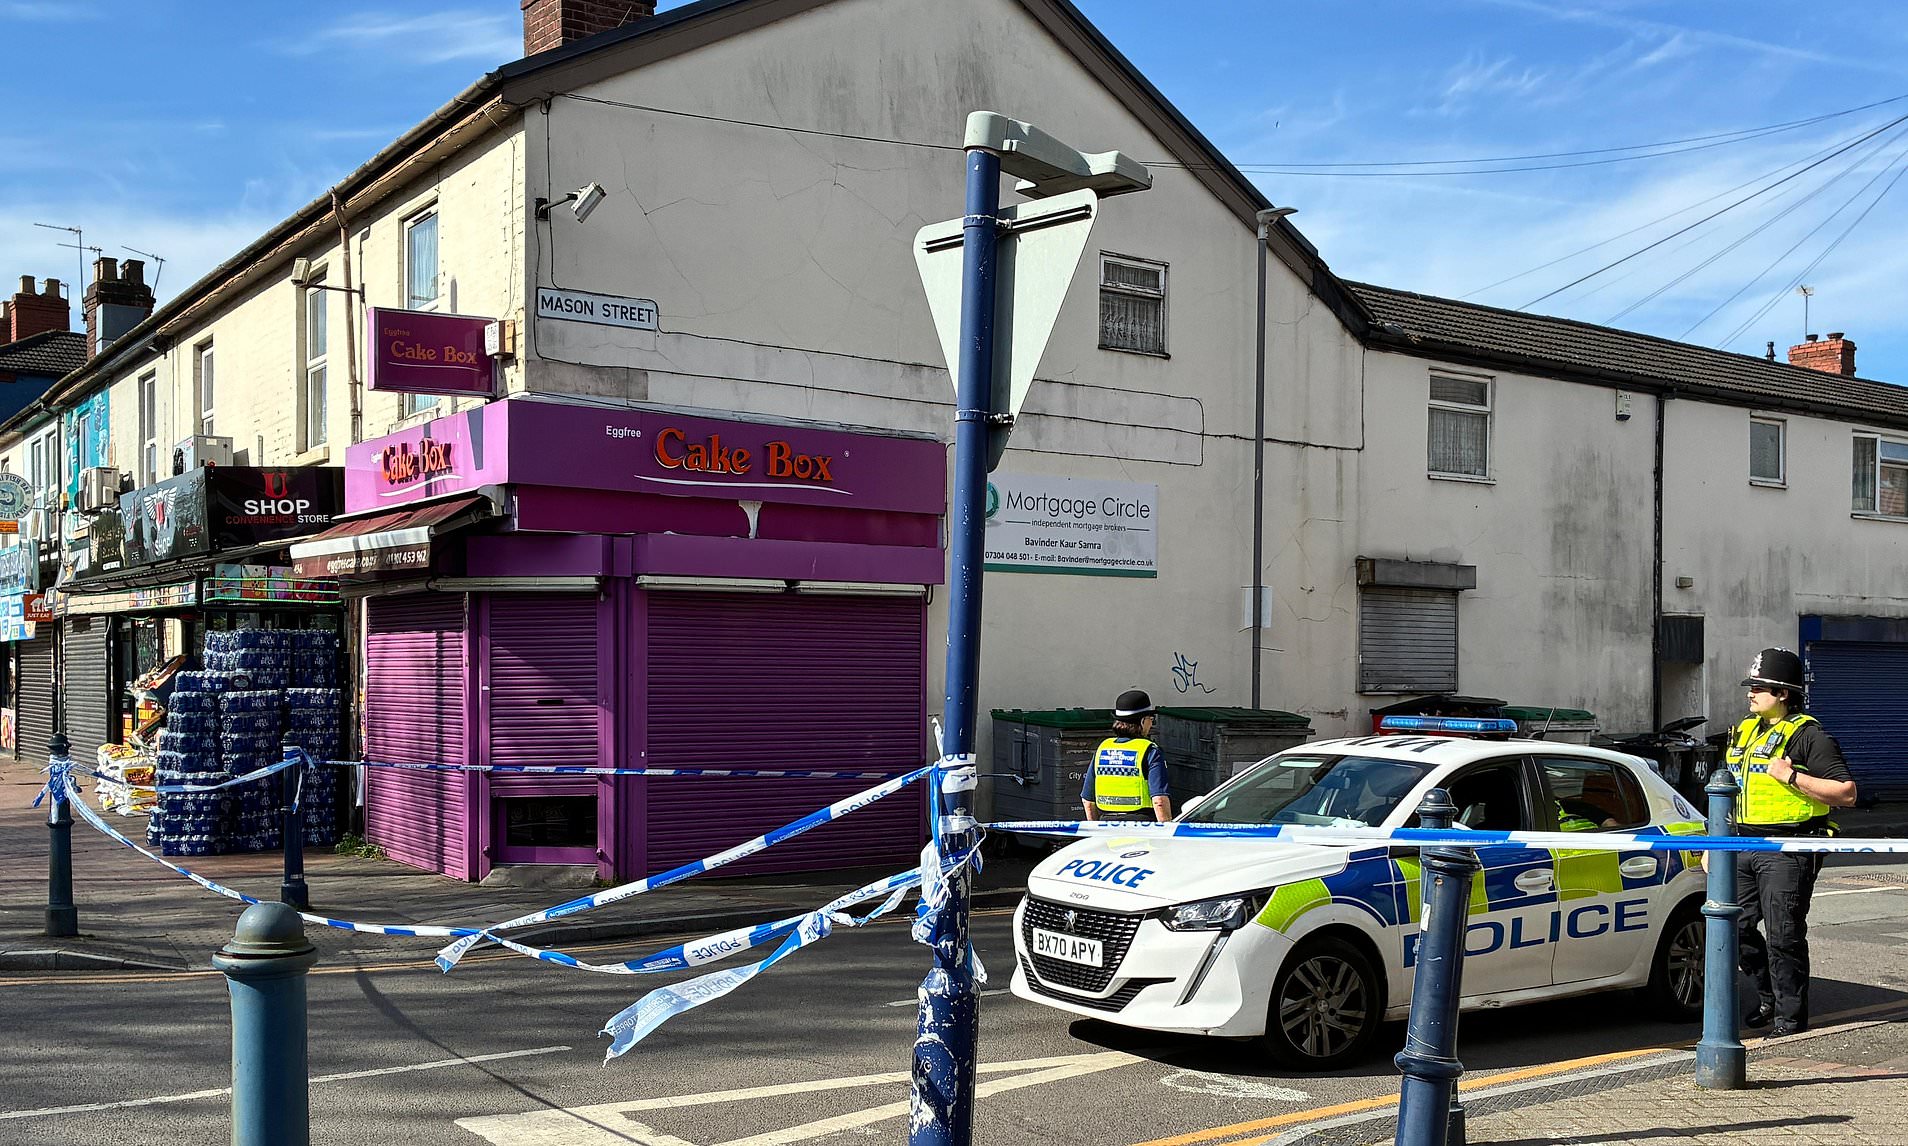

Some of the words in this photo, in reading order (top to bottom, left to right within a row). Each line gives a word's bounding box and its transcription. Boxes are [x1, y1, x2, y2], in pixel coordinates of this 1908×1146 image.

[541, 295, 594, 316] MASON
[602, 303, 654, 323] STREET
[384, 327, 411, 337] Eggfree
[390, 340, 437, 361] Cake
[443, 346, 478, 364] Box
[606, 425, 641, 439] Eggfree
[381, 443, 415, 485] Cake
[419, 437, 450, 473] Box
[654, 427, 752, 475] Cake
[765, 441, 833, 481] Box
[262, 473, 288, 499] U
[244, 499, 310, 516] SHOP
[1006, 490, 1097, 518] Mortgage
[1102, 497, 1151, 519] Circle
[225, 515, 296, 525] CONVENIENCE
[298, 514, 329, 524] STORE
[1031, 519, 1072, 528] independent
[1073, 522, 1103, 531] mortgage
[1104, 524, 1126, 532] brokers
[985, 551, 1005, 559] 07304
[1006, 552, 1018, 560] 048
[1025, 537, 1059, 548] Bavinder
[1060, 539, 1077, 548] Kaur
[1079, 541, 1102, 550] Samra
[1056, 859, 1156, 889] POLICE
[1038, 932, 1068, 957] BX70
[1070, 940, 1096, 963] APY
